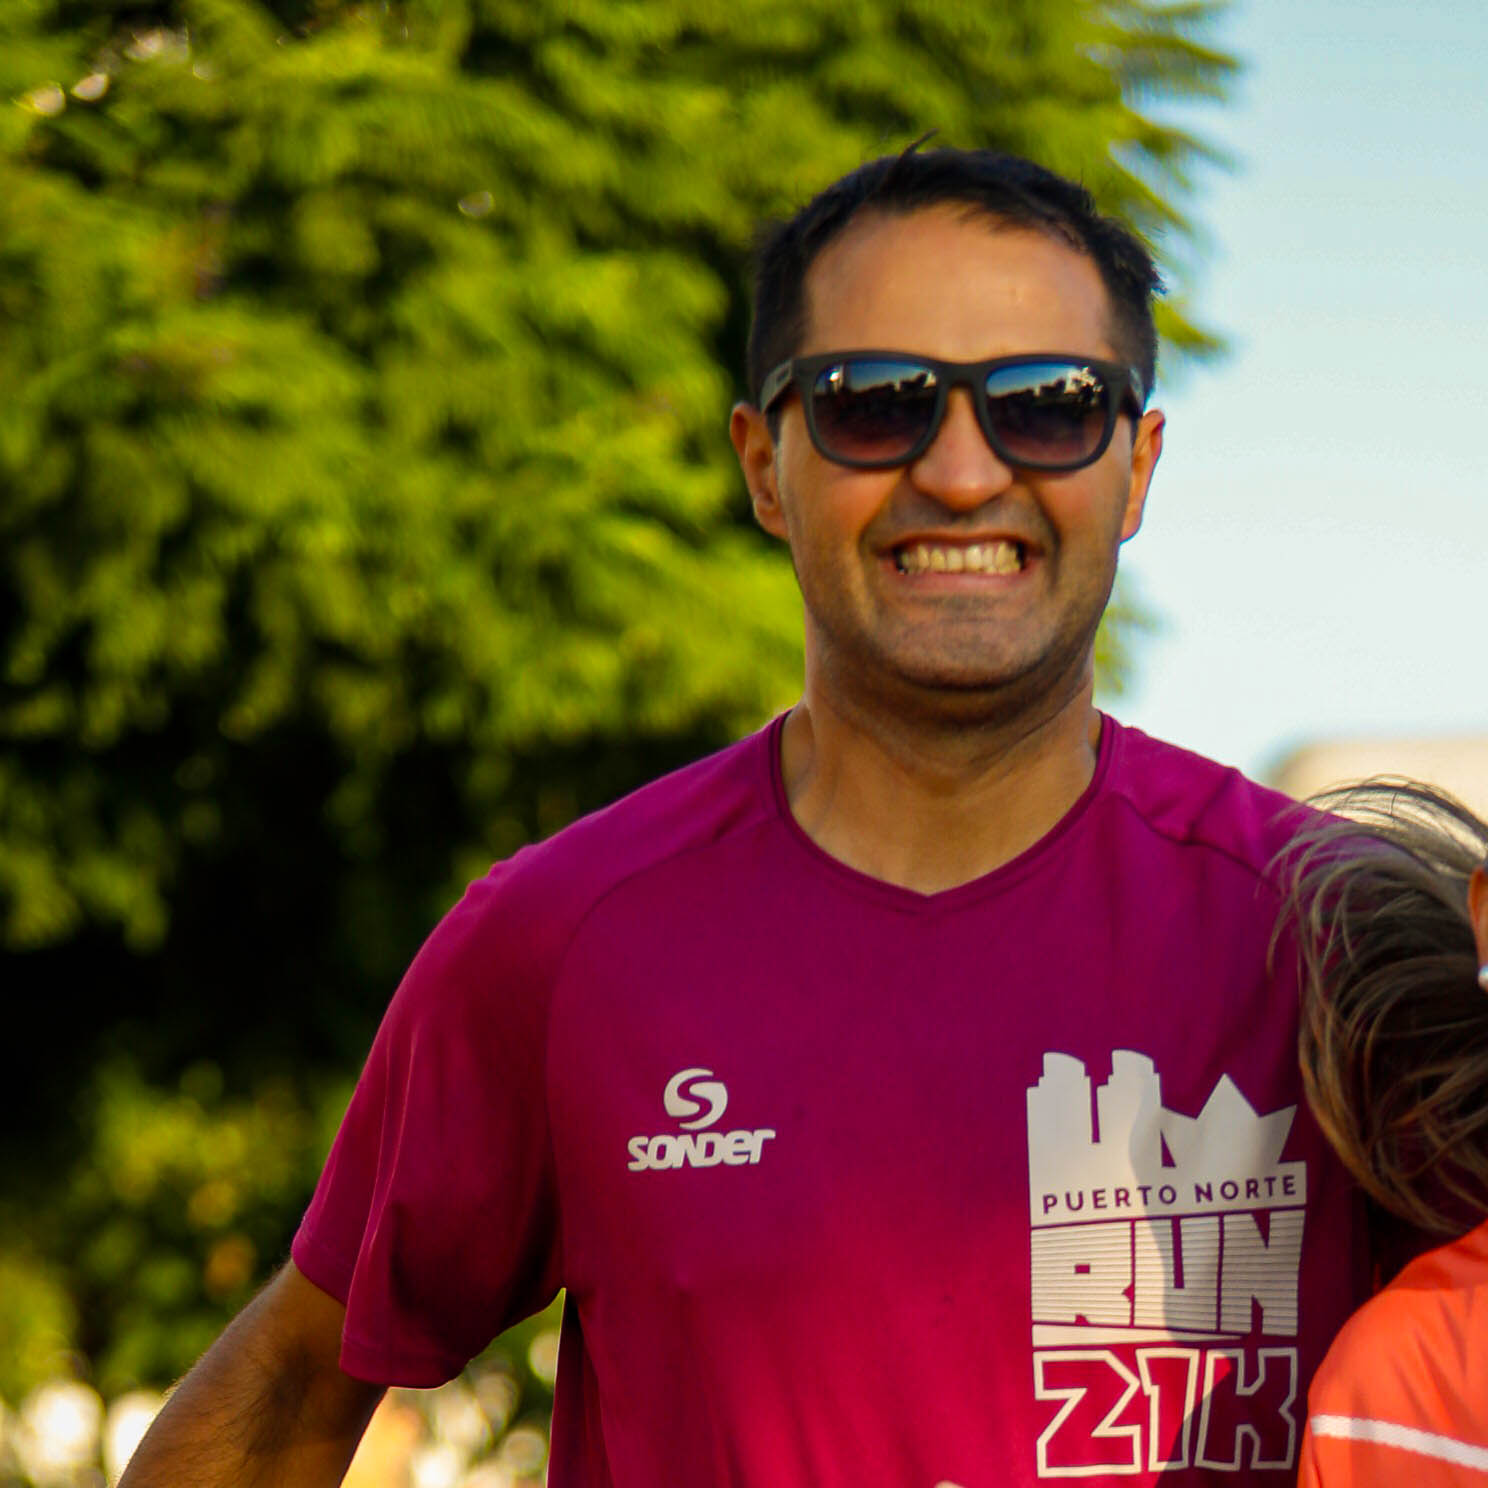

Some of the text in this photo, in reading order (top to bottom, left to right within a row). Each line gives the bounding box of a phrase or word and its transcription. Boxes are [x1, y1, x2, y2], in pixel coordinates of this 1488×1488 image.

[1042, 1174, 1296, 1215] PUERTO NORTE
[1030, 1209, 1306, 1337] RUN
[1034, 1346, 1298, 1478] 21K
